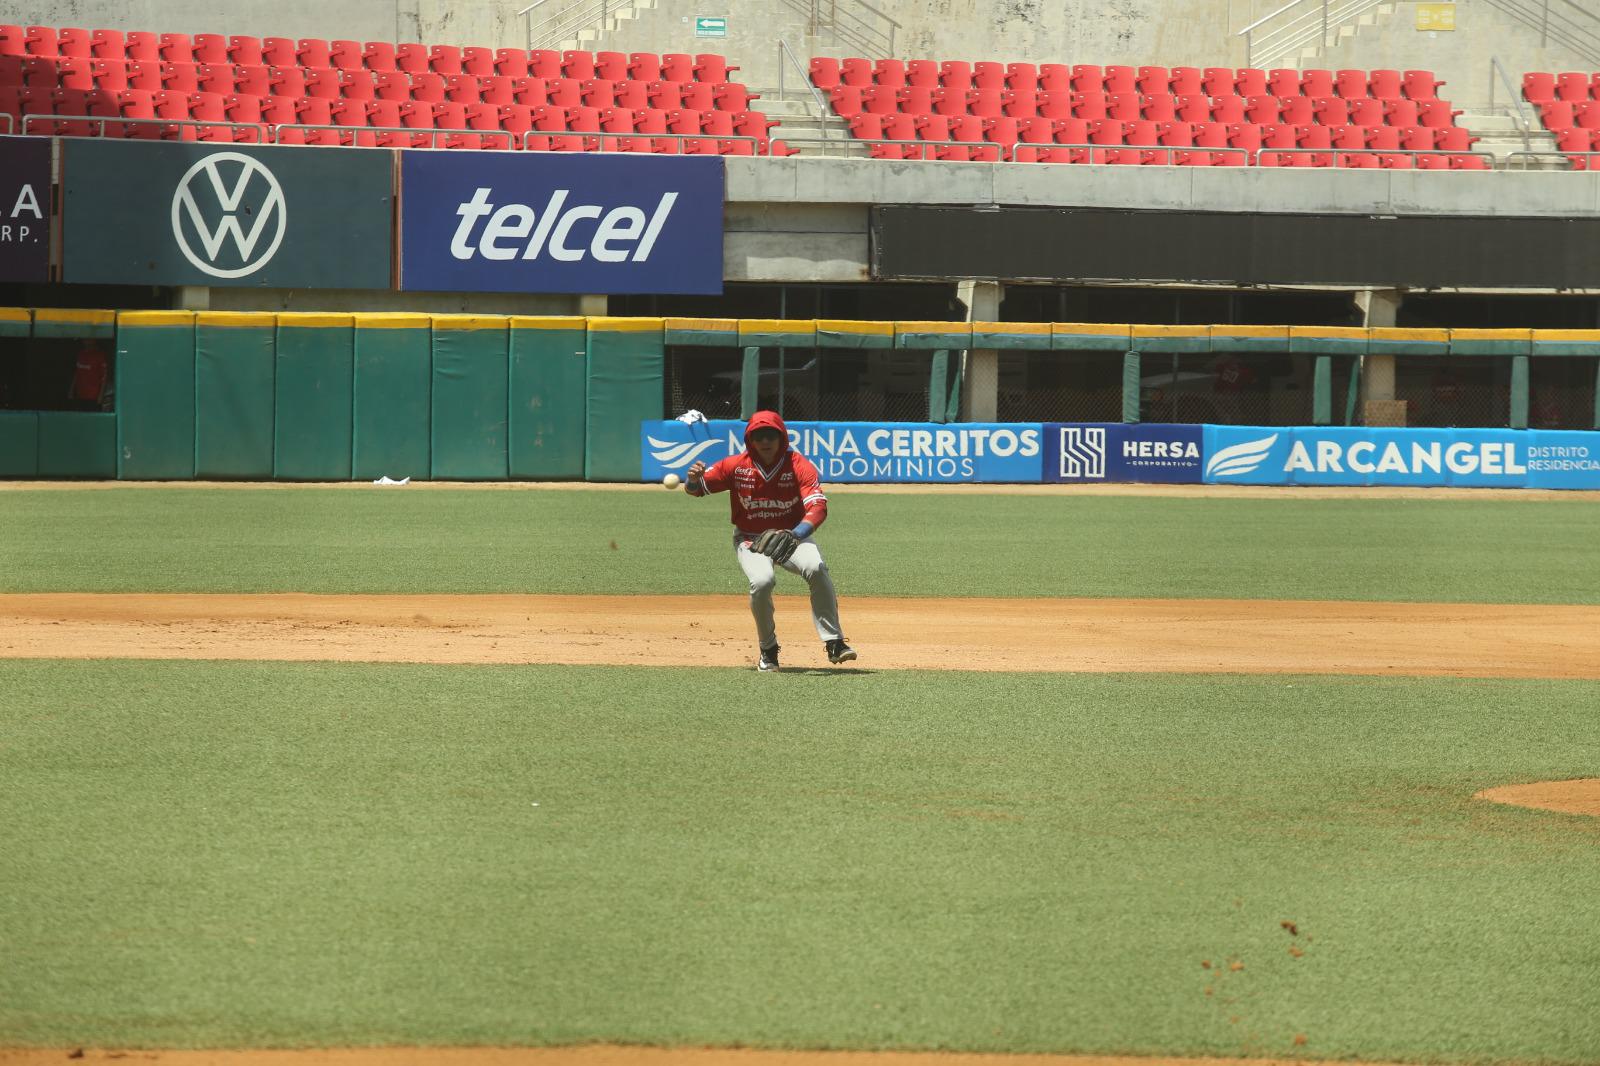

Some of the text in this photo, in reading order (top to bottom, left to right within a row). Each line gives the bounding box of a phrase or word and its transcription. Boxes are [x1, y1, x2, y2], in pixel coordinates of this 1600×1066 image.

[0, 184, 43, 219] A
[451, 187, 679, 262] telcel
[728, 429, 1040, 457] MRINA CERRITOS
[1123, 441, 1200, 458] HERSA
[1528, 446, 1589, 458] DISTRITO
[808, 458, 974, 477] NDOMINIOS
[1283, 441, 1527, 474] ARCANGEL
